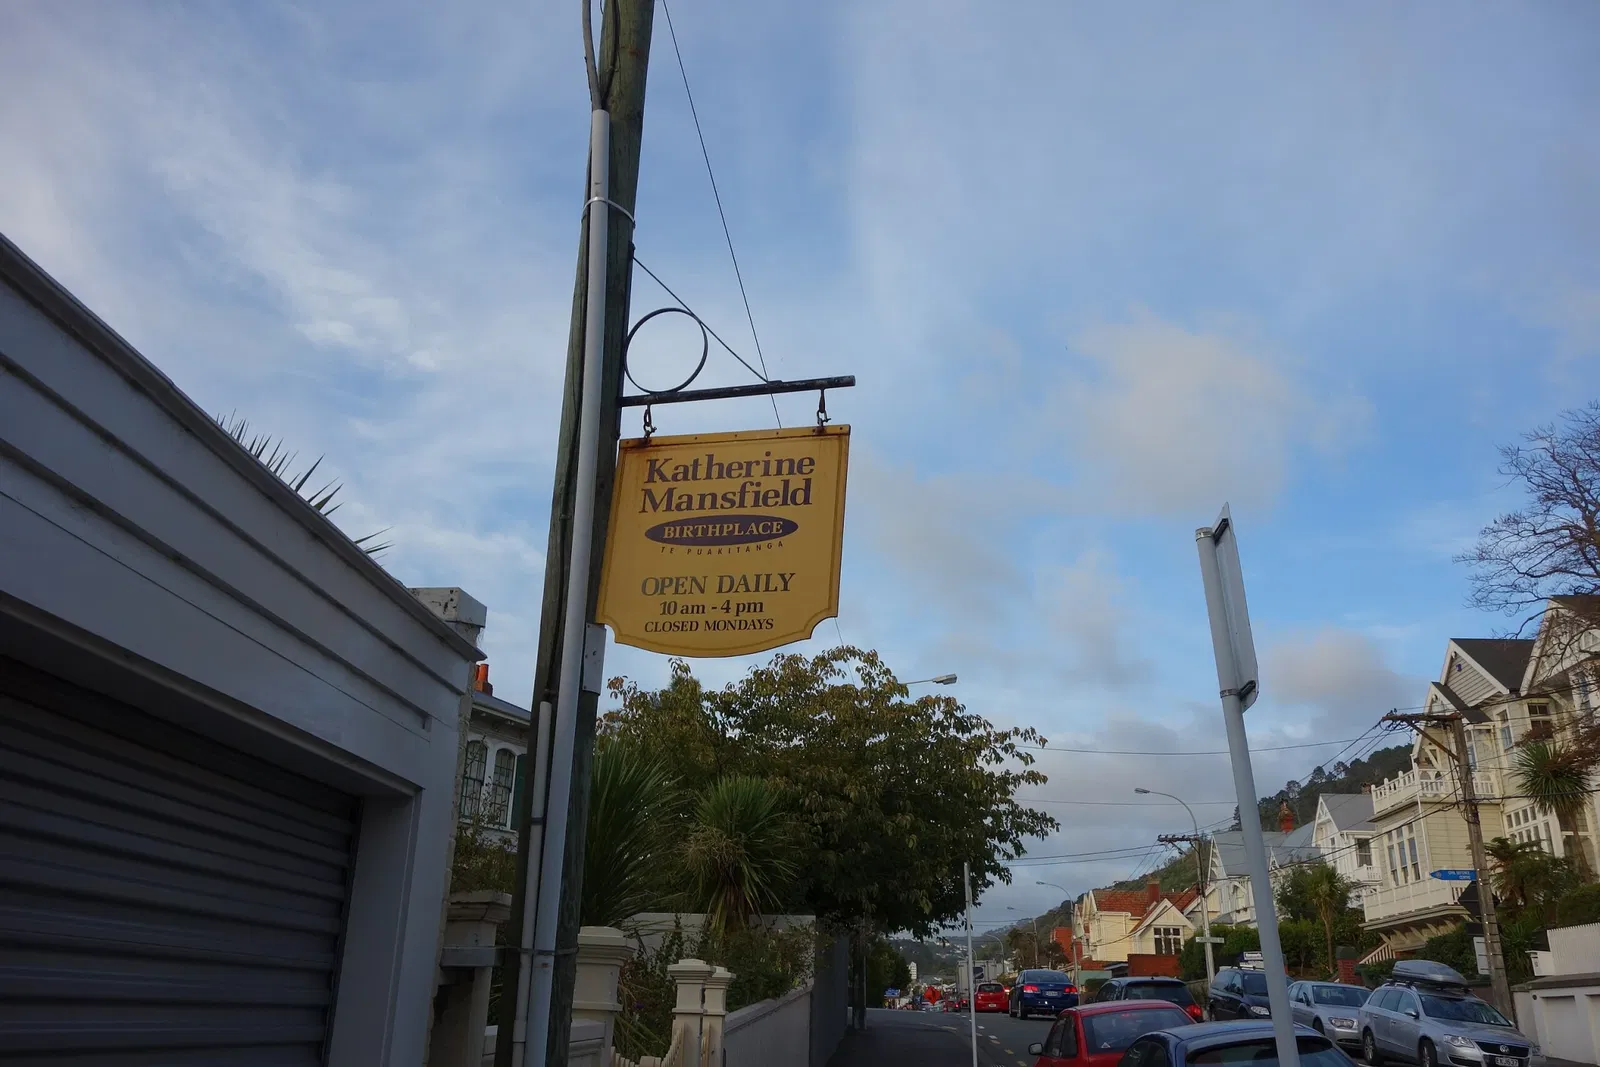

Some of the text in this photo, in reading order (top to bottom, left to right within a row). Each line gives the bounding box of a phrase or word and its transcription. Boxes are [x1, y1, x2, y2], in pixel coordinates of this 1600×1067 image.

[644, 451, 815, 484] Katherine
[638, 478, 813, 513] Mansfield
[663, 521, 783, 539] BIRTHPLACE
[687, 540, 784, 555] PUAKITANGA
[641, 572, 796, 596] OPEN DAILY
[721, 600, 731, 614] 4
[644, 618, 774, 633] CLOSED MONDAYS
